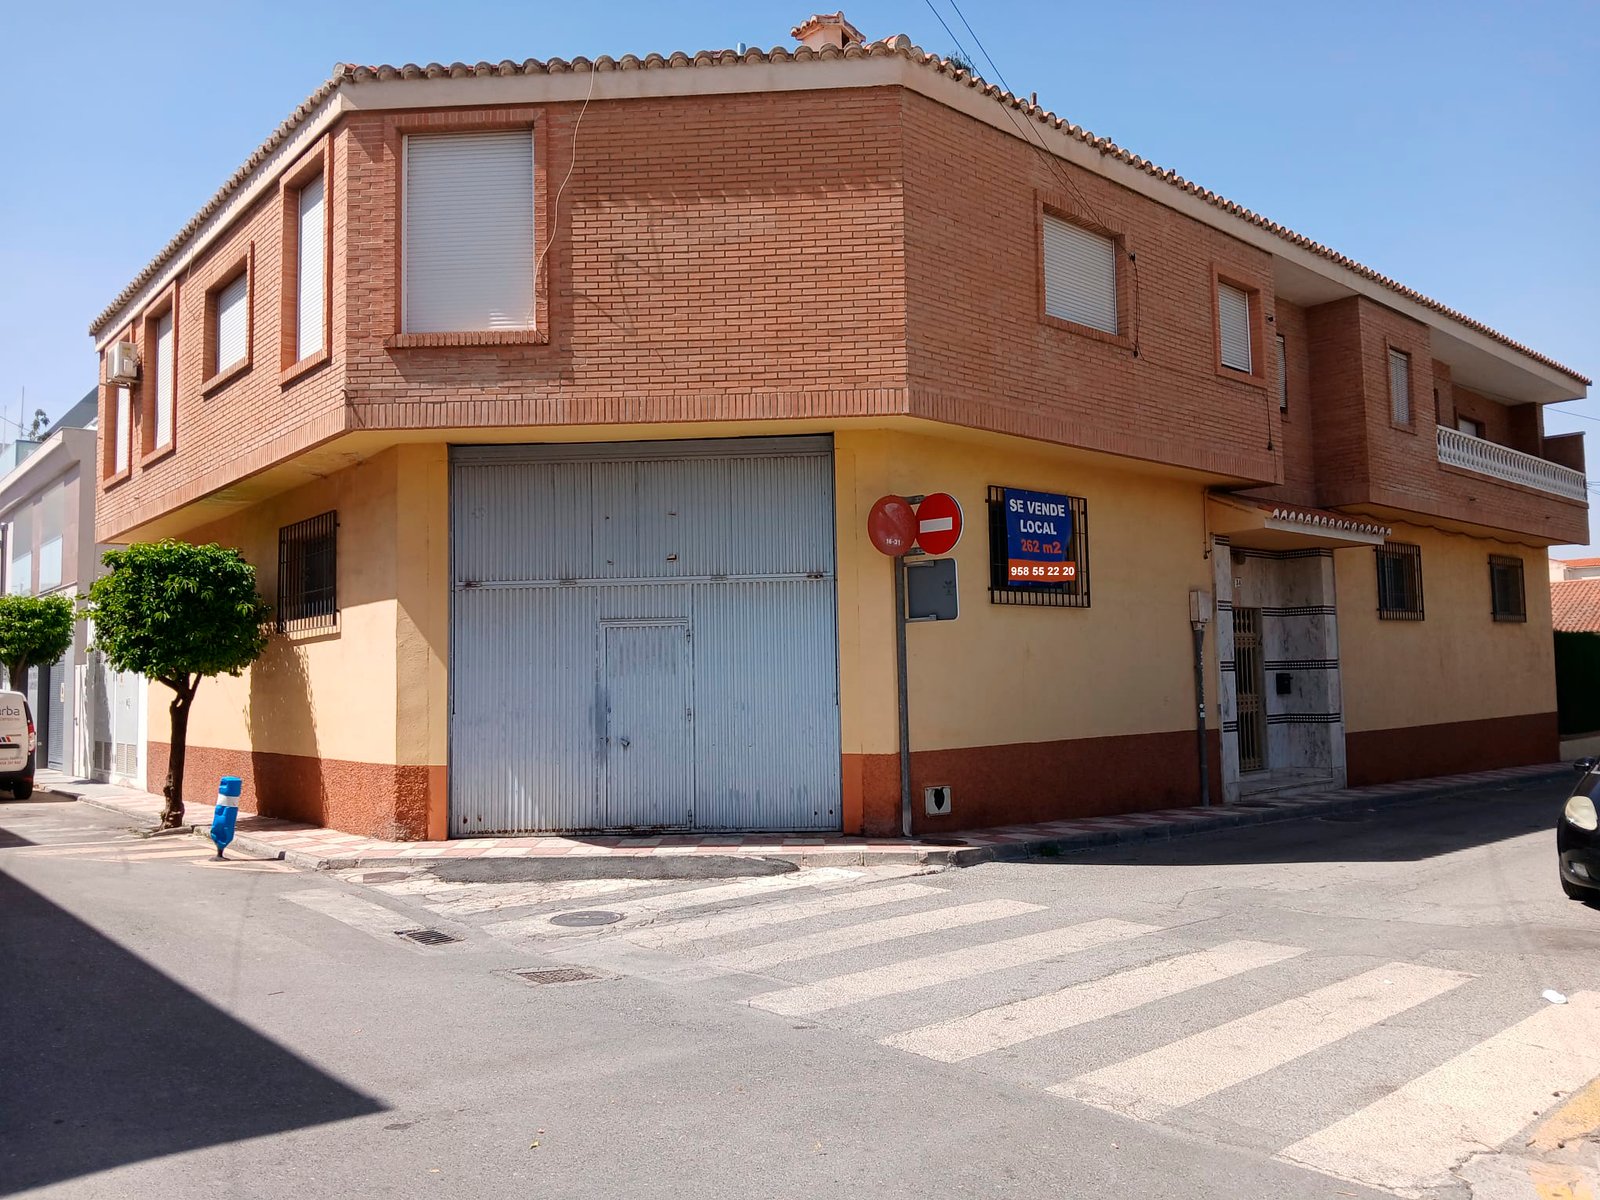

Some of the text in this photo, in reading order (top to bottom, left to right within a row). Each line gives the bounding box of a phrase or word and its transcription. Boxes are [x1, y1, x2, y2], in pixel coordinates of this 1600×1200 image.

[1009, 499, 1066, 517] SE VENDE
[1020, 519, 1057, 535] LOCAL
[1021, 538, 1062, 554] 262 m2
[1011, 566, 1075, 576] 958 55 22 20
[0, 704, 20, 716] rba
